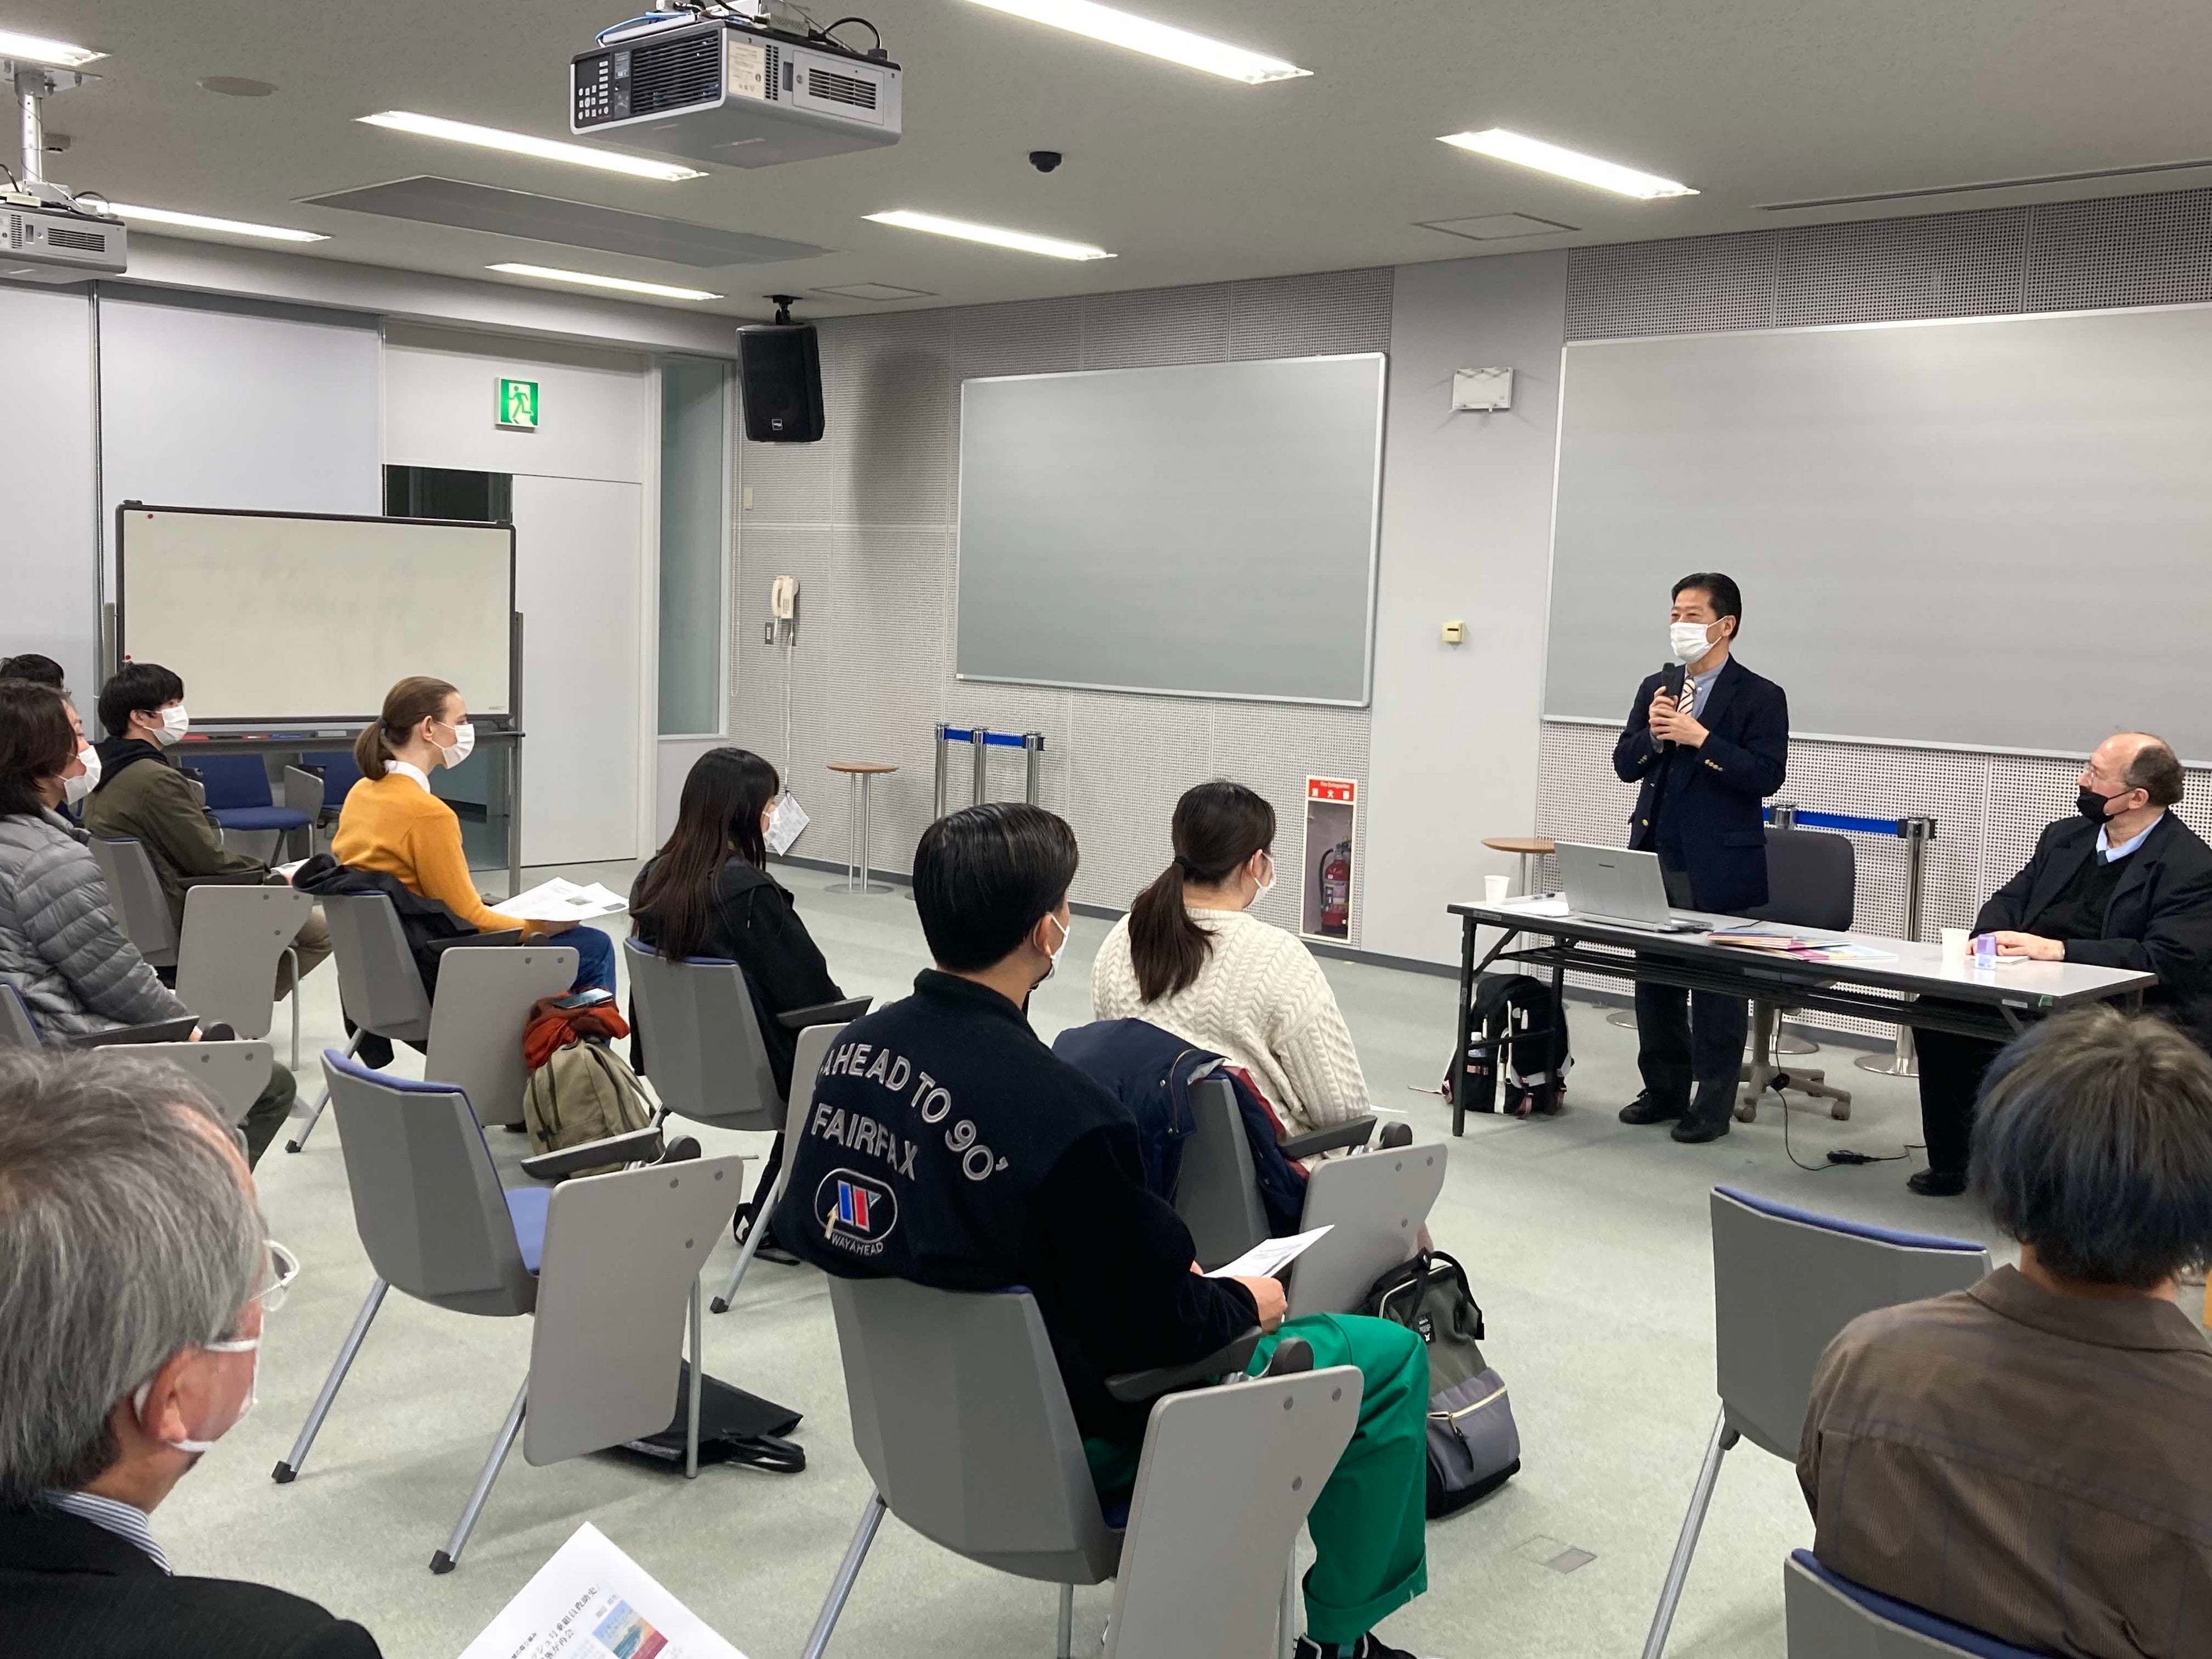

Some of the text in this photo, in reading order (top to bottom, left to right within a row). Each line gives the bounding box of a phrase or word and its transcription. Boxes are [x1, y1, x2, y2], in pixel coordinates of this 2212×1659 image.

[820, 1043, 911, 1091] AHEAD
[911, 1071, 951, 1123] TO
[811, 1103, 918, 1181] FAIRFAX
